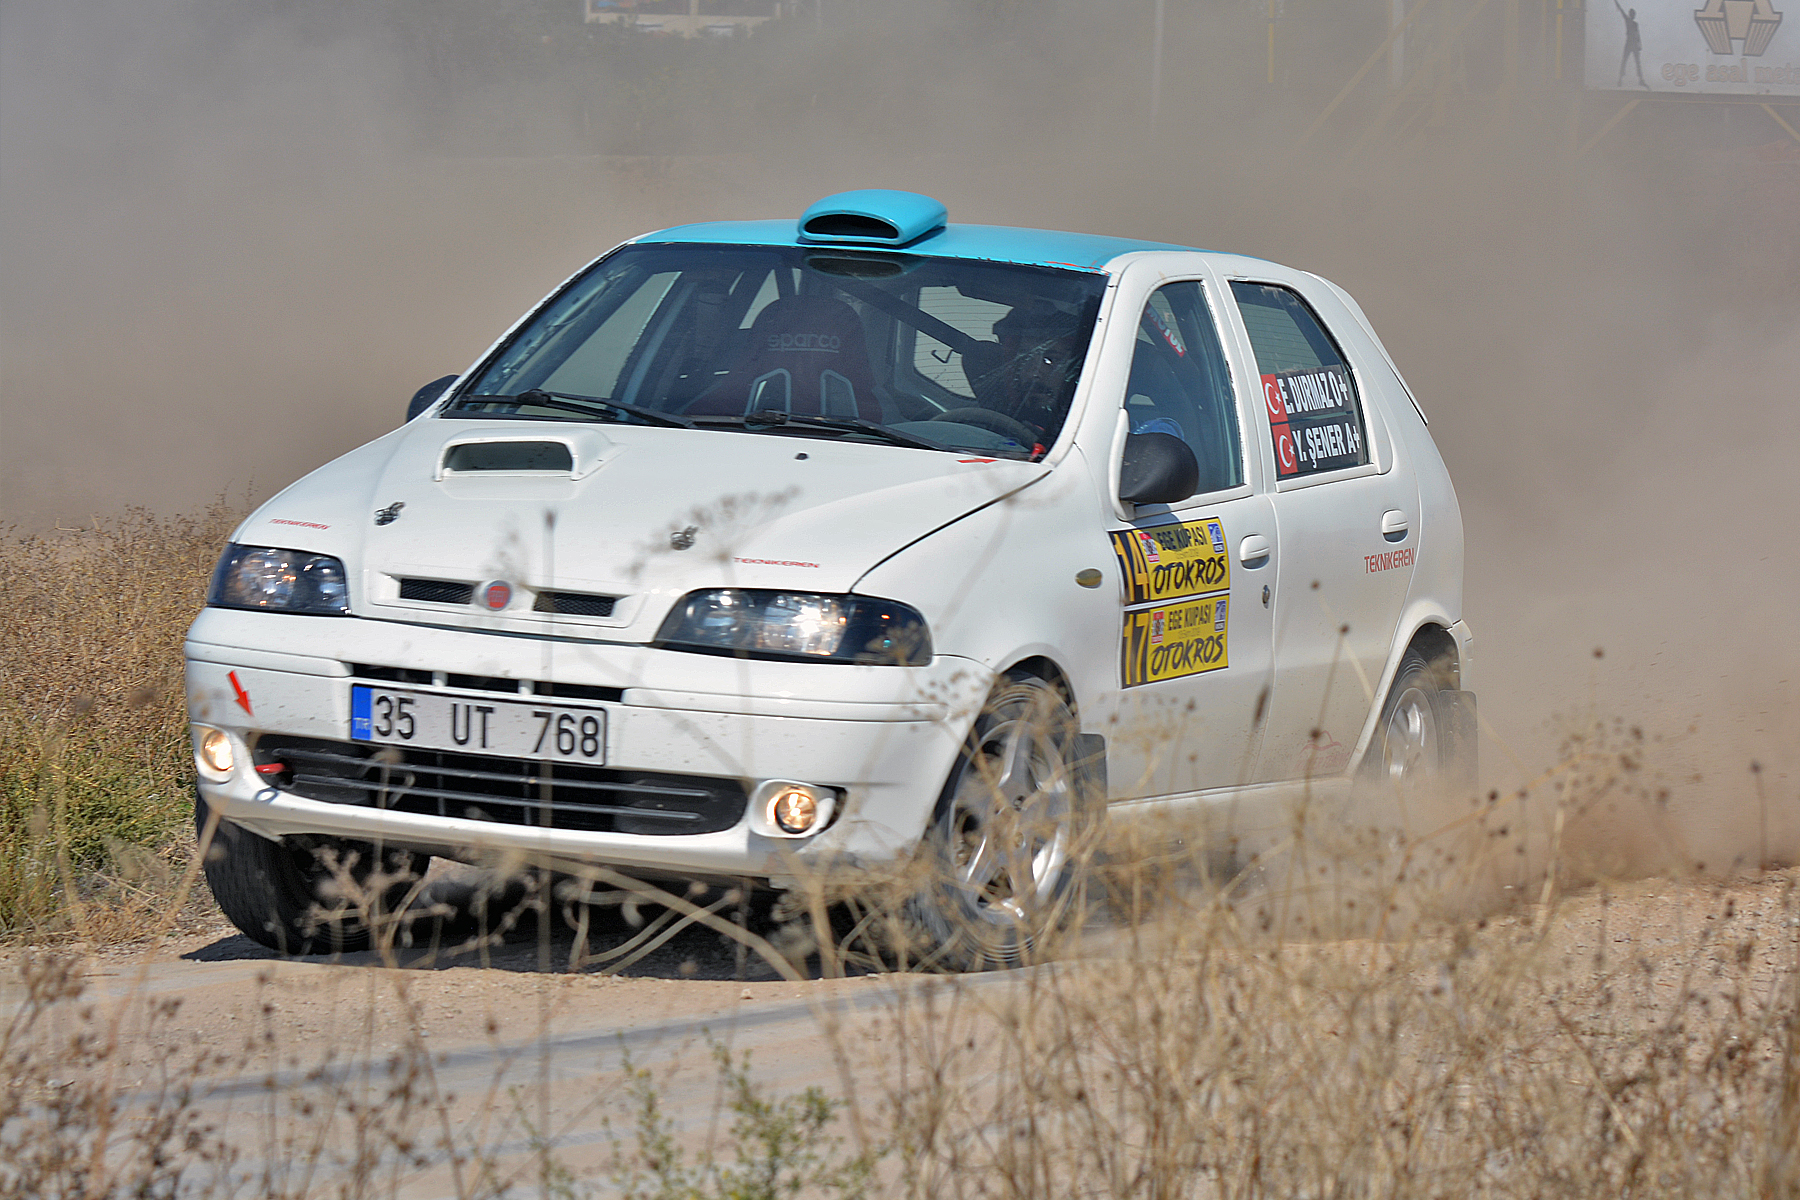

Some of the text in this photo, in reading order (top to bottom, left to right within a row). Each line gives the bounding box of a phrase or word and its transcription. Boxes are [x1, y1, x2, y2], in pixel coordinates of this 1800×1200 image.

[1661, 62, 1699, 87] ege
[1705, 57, 1748, 83] asal
[767, 333, 841, 352] sparco
[1287, 372, 1335, 413] DURMAZ
[1327, 370, 1349, 407] O+
[1291, 422, 1360, 469] Y. ŞENER A+
[1156, 525, 1208, 551] EGE KUPASI
[1112, 531, 1149, 602] 14
[1152, 555, 1226, 595] OTOKROS
[1168, 603, 1212, 631] EGE KUPASI
[1122, 612, 1150, 685] 17
[1150, 633, 1226, 676] OTOKROS
[353, 717, 370, 731] TR
[375, 695, 599, 758] 35 UT 768
